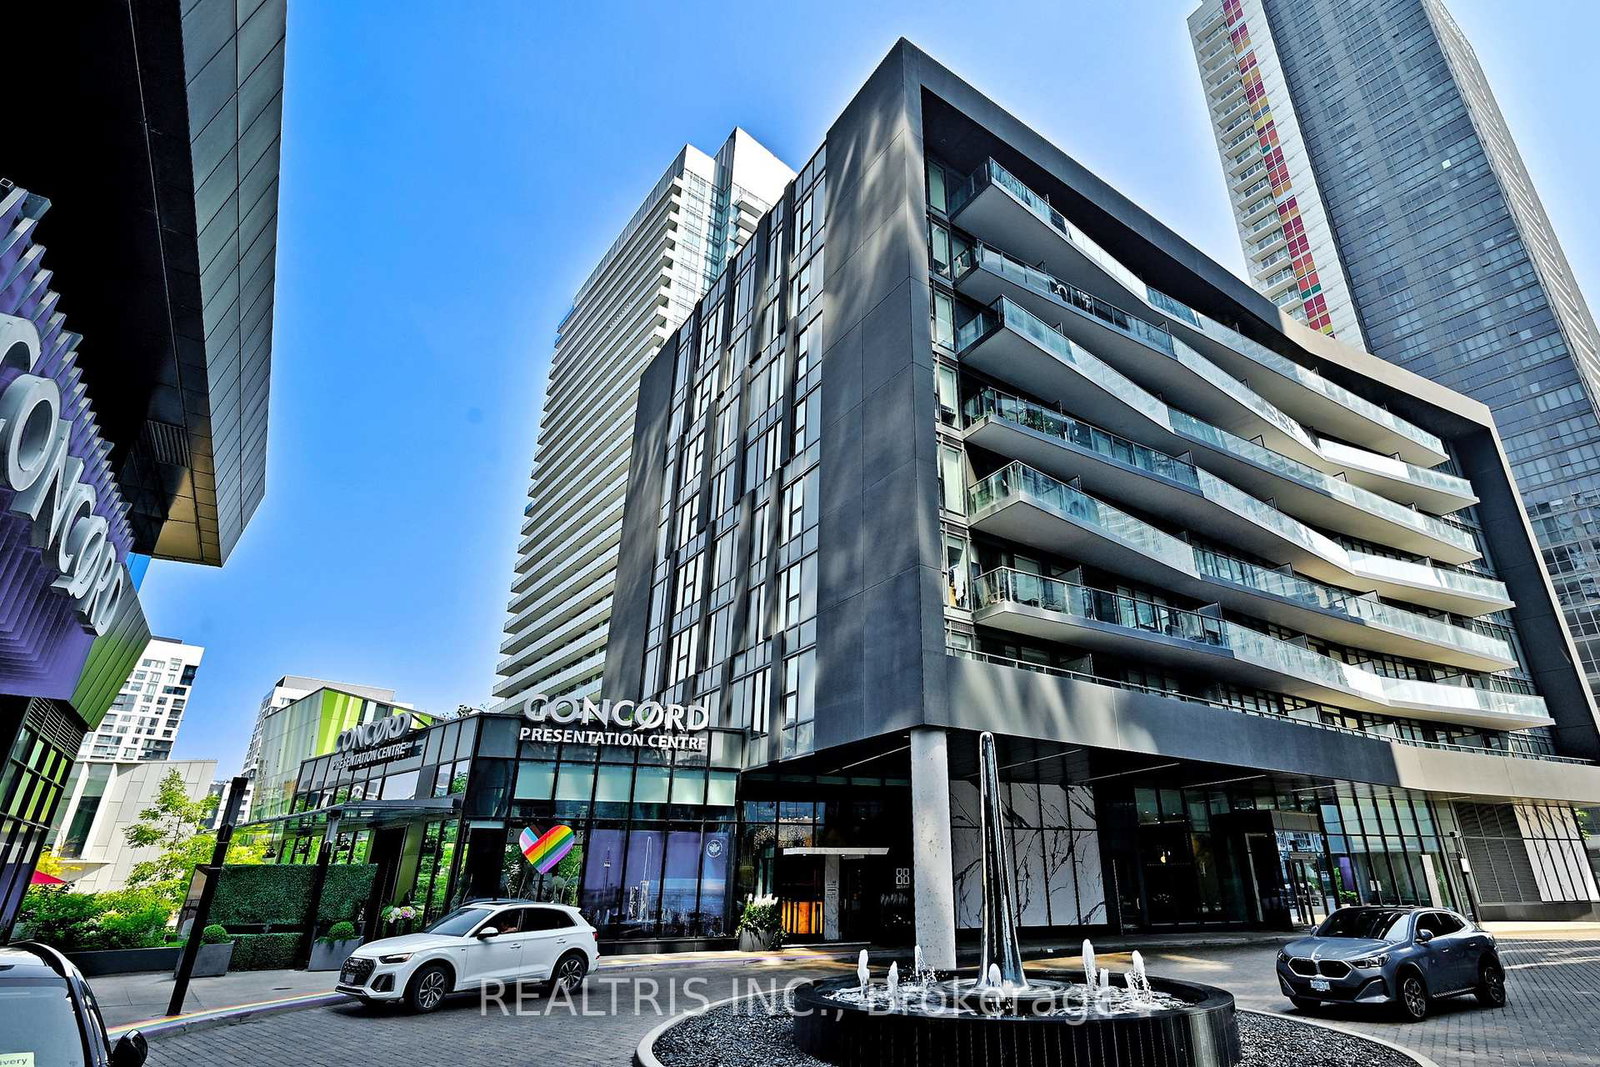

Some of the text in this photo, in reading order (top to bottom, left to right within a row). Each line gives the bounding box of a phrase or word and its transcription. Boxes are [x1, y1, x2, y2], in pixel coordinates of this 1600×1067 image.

[519, 727, 706, 750] PRESENTATION CENTRE
[332, 742, 406, 770] PRESENTATION CENTRE
[896, 868, 910, 884] 88
